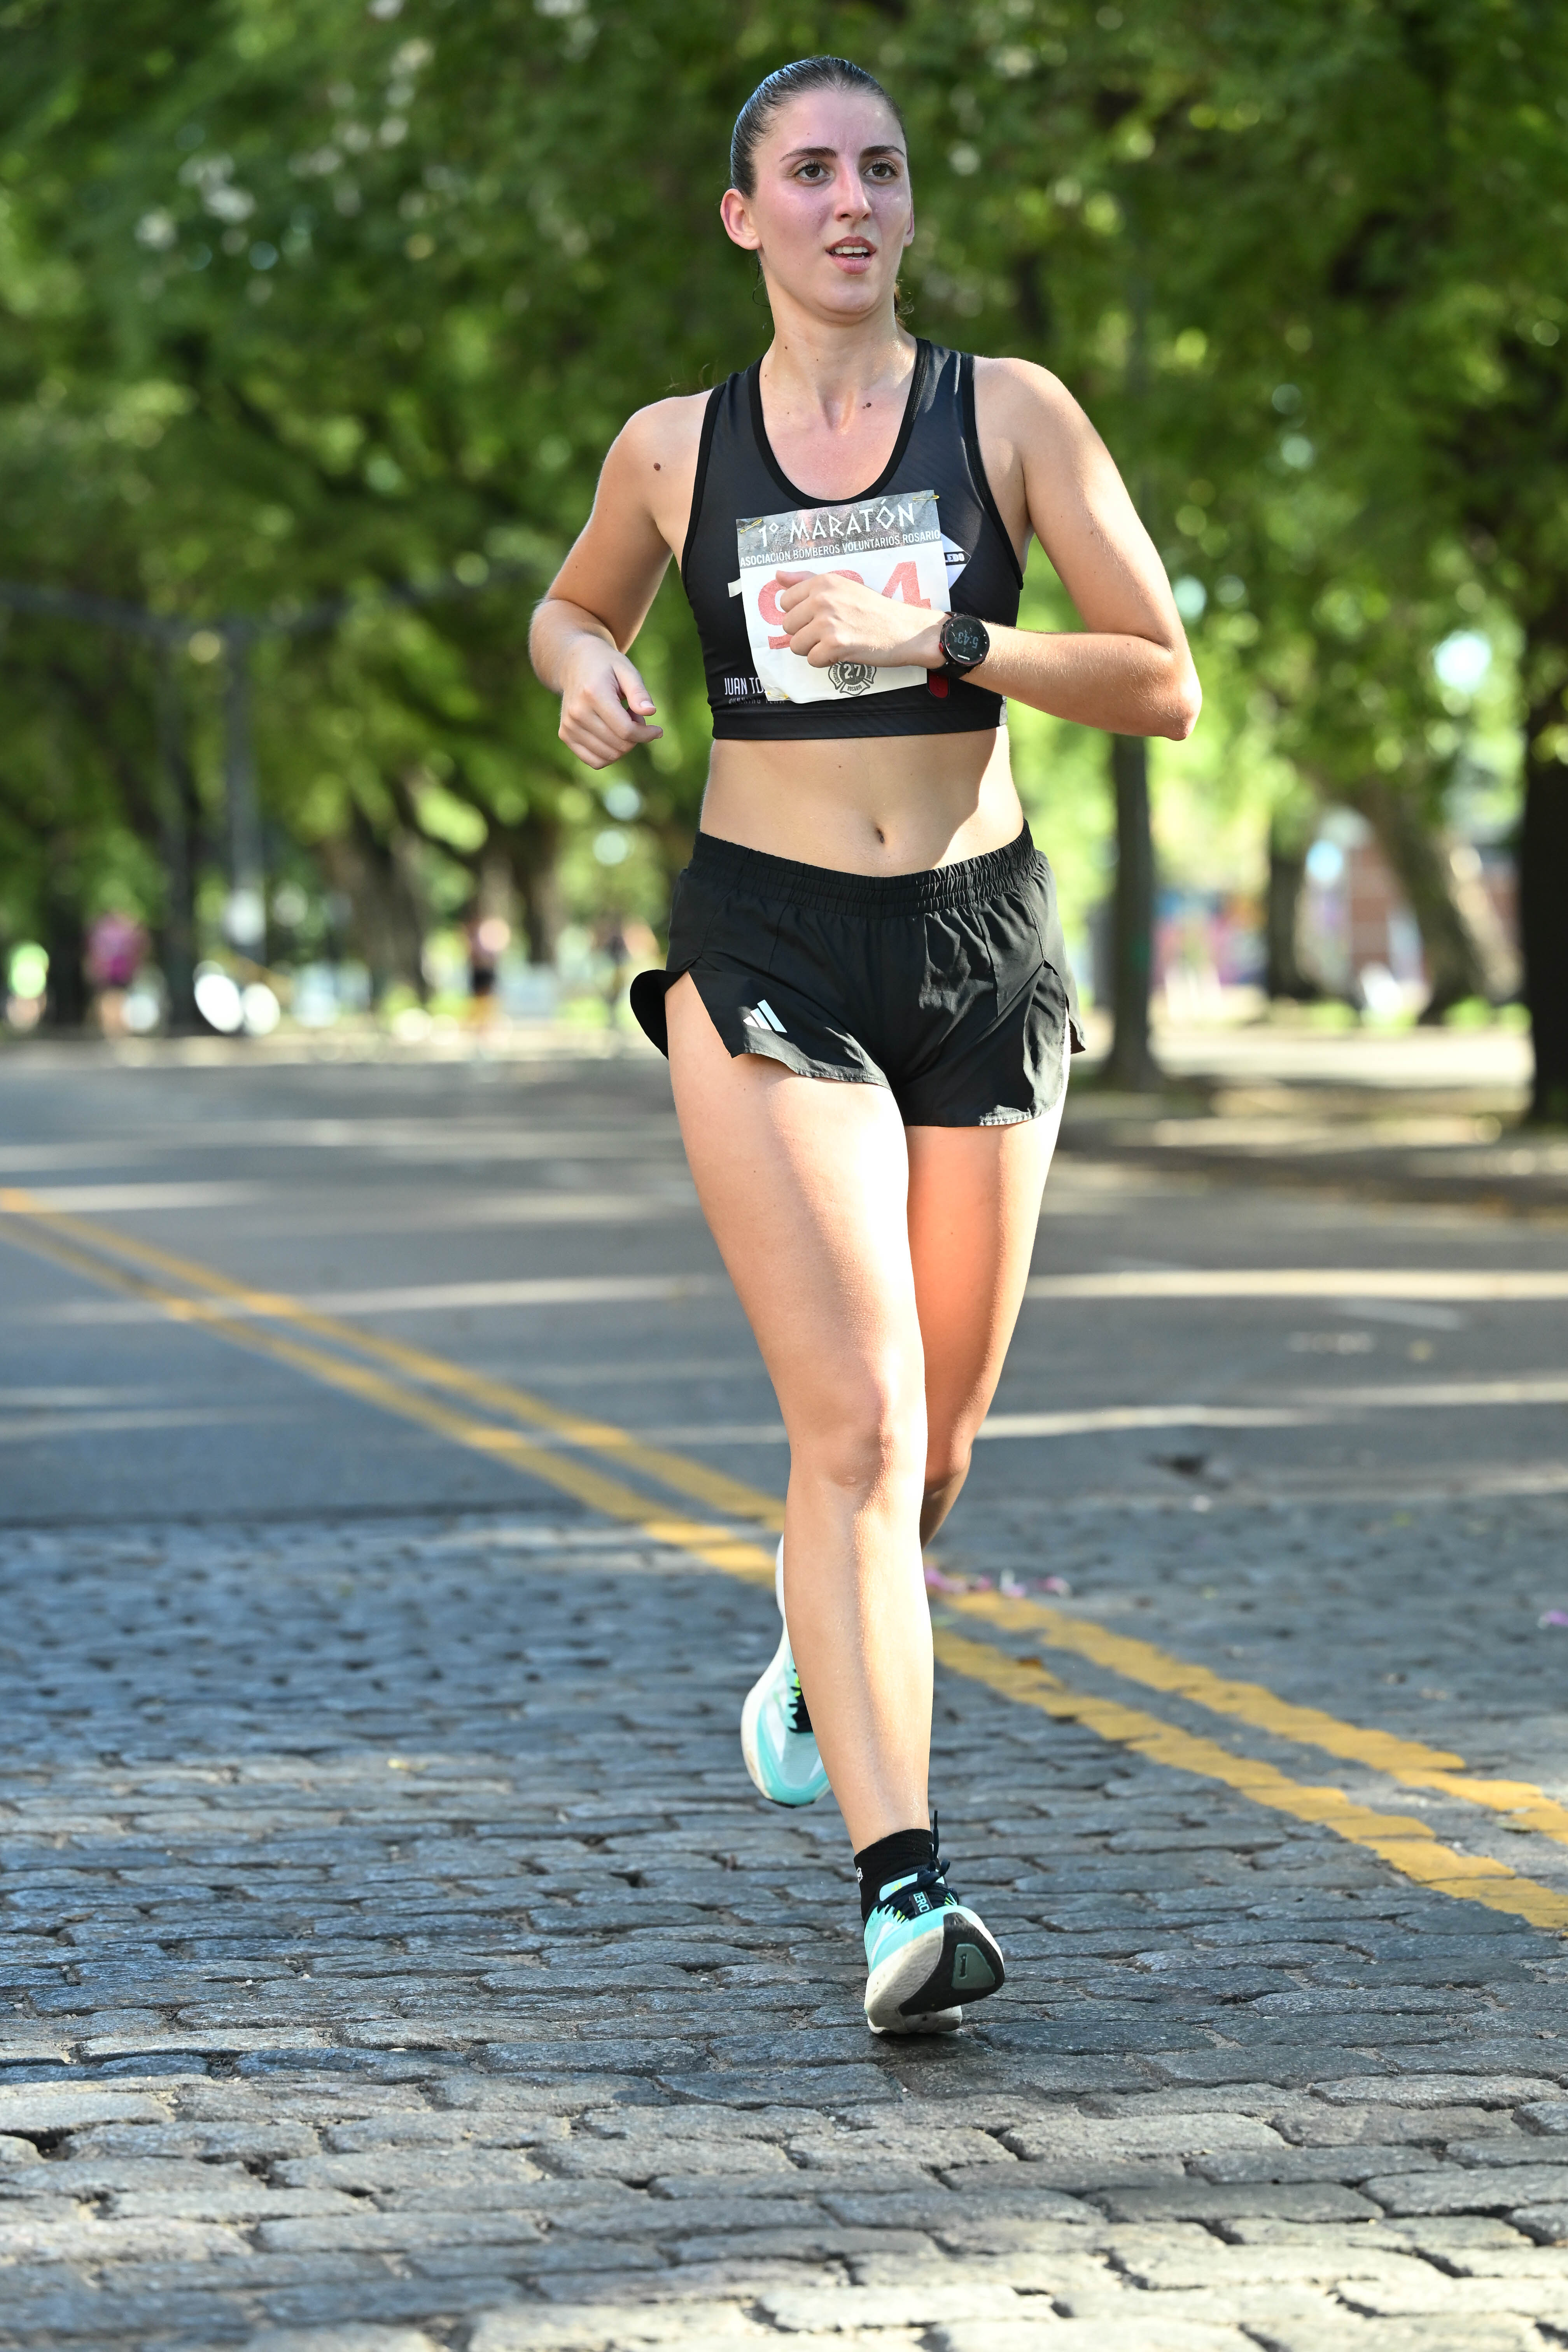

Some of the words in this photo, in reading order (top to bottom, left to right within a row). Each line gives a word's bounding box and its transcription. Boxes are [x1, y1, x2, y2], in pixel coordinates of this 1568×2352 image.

[789, 498, 915, 543] MARATÓN
[793, 544, 840, 559] BOMBEROS
[842, 535, 900, 553] VOLUNTARIOS
[902, 529, 941, 543] ROSARIO
[758, 561, 932, 649] 94
[724, 677, 748, 695] JUAN
[749, 677, 764, 694] TO
[844, 664, 861, 679] 27
